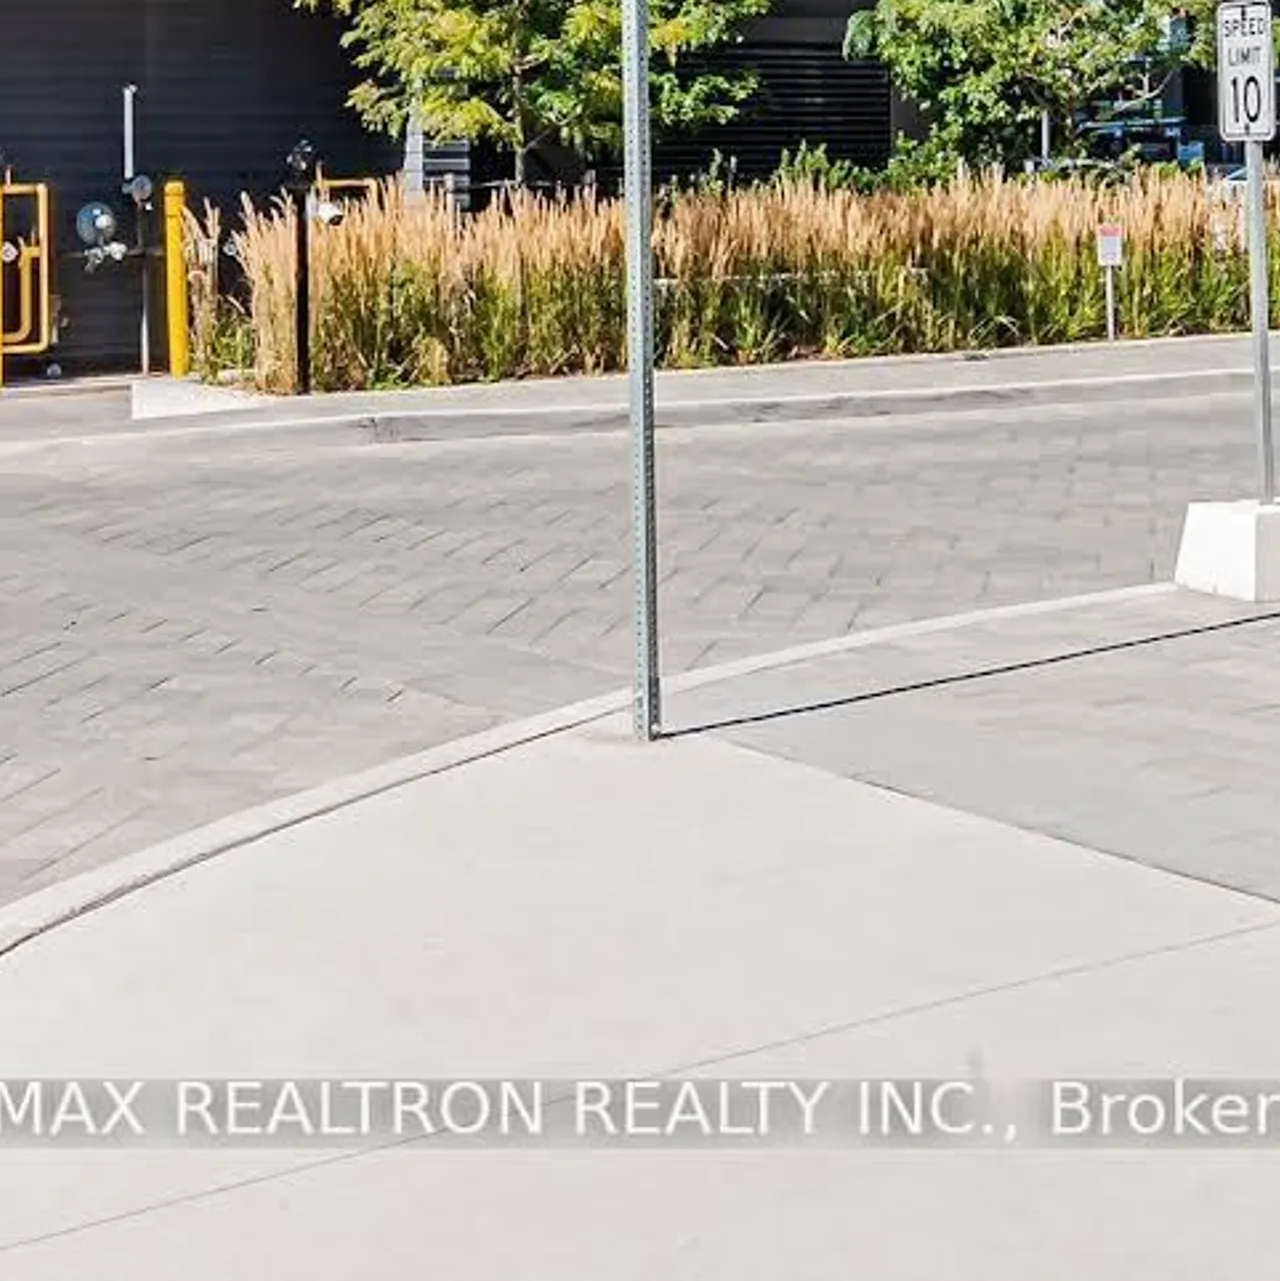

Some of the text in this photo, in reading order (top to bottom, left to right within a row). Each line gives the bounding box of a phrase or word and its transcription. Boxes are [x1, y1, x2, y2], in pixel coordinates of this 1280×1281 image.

[1224, 17, 1265, 38] SPEED
[1228, 47, 1262, 66] LIMIT
[1231, 76, 1261, 123] 10
